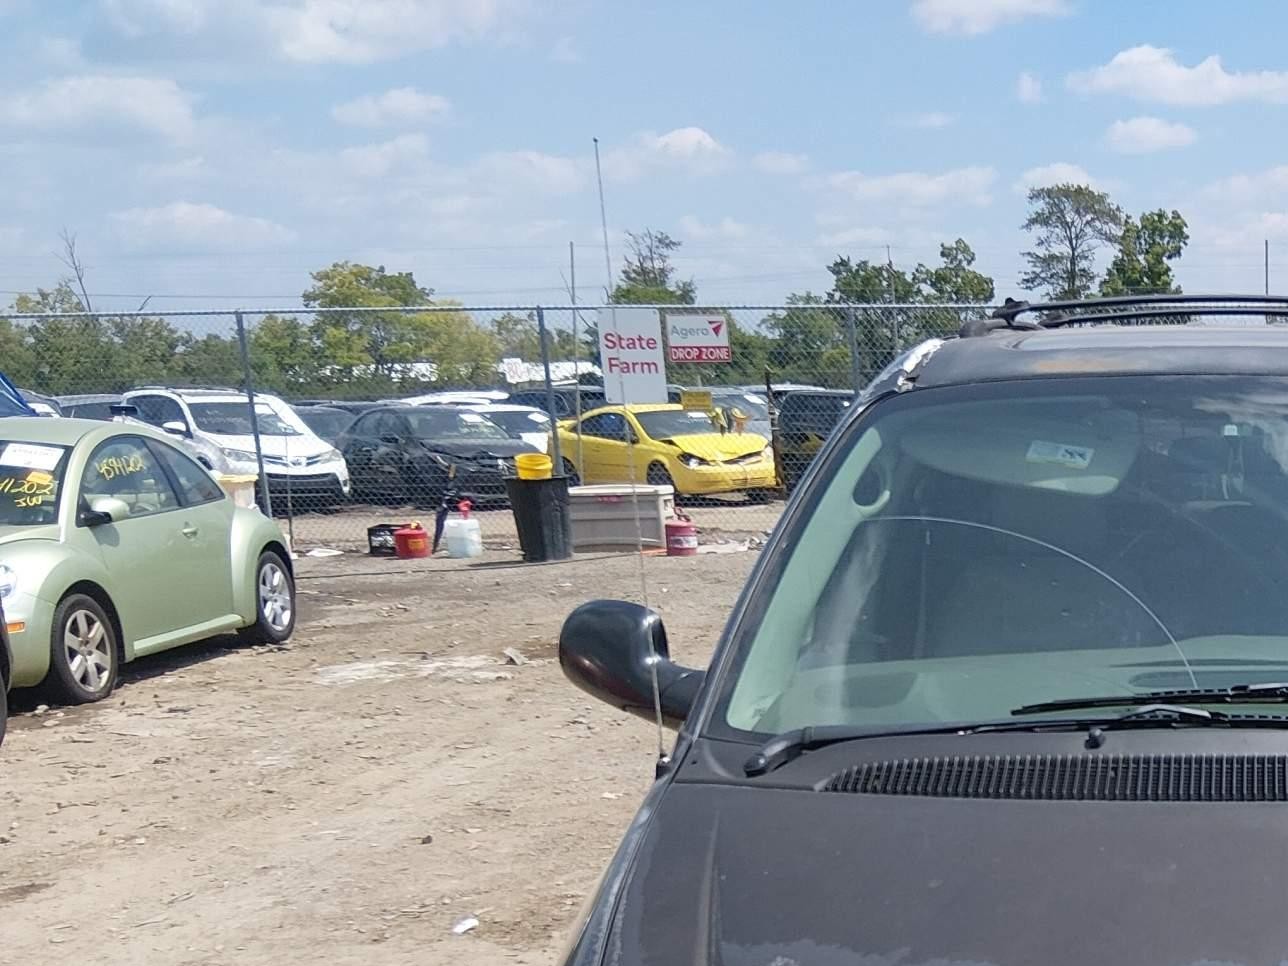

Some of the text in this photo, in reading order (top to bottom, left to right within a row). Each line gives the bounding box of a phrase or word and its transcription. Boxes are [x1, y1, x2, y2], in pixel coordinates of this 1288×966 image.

[671, 325, 710, 339] Agero
[603, 332, 657, 350] State
[671, 347, 730, 360] DROP ZONE
[607, 357, 659, 374] Farm
